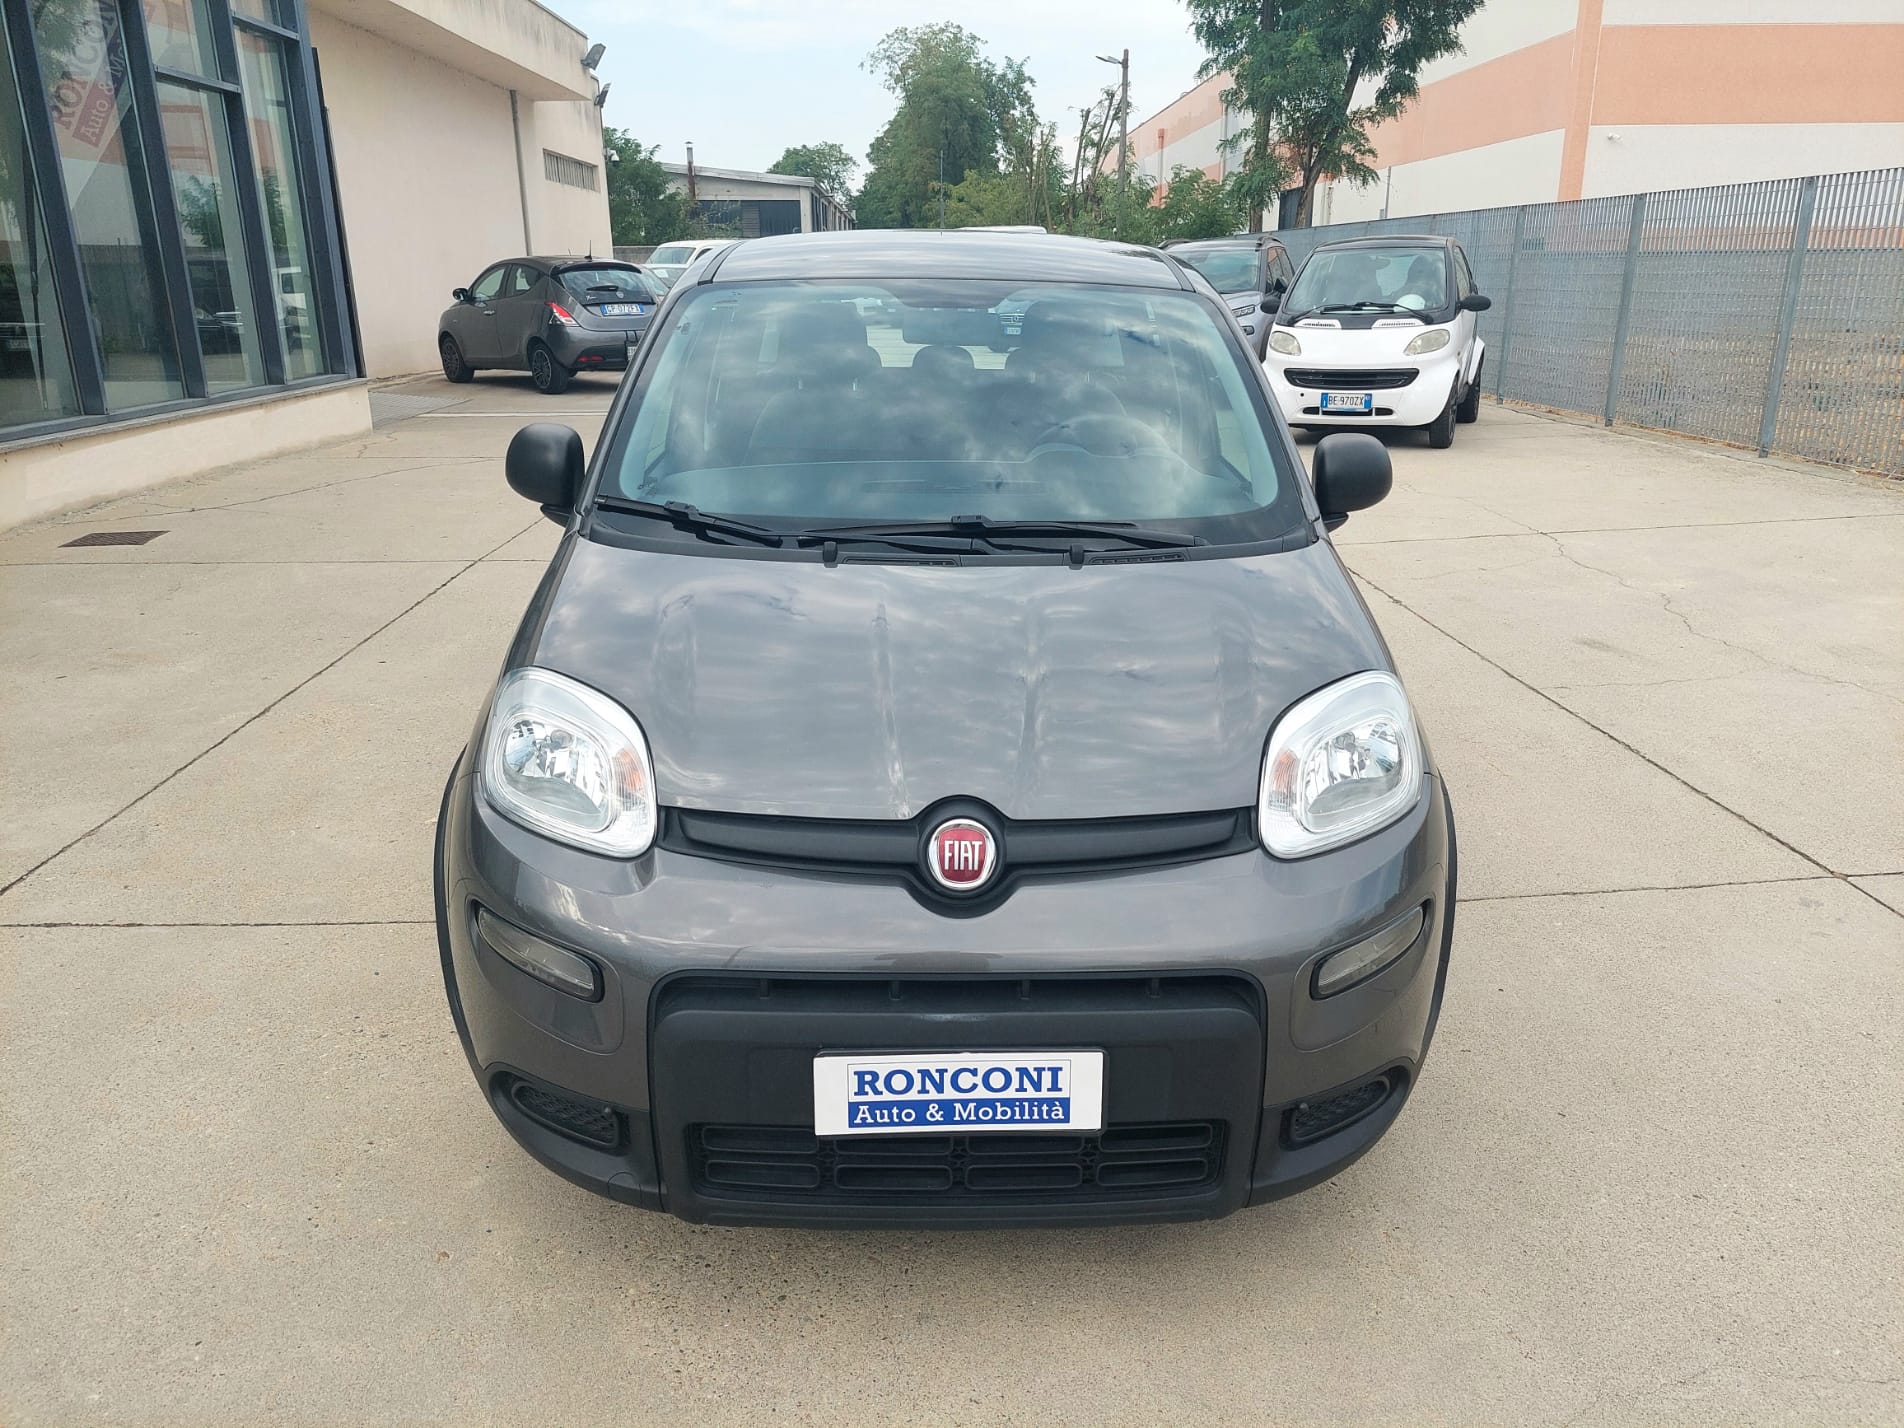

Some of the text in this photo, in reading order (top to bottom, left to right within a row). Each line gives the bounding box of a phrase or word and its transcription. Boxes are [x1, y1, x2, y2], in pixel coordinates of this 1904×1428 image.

[1328, 395, 1338, 405] BE
[944, 840, 982, 871] FIAT
[853, 1066, 1064, 1097] RONCONI
[853, 1100, 1066, 1124] Auto & Mobilità
